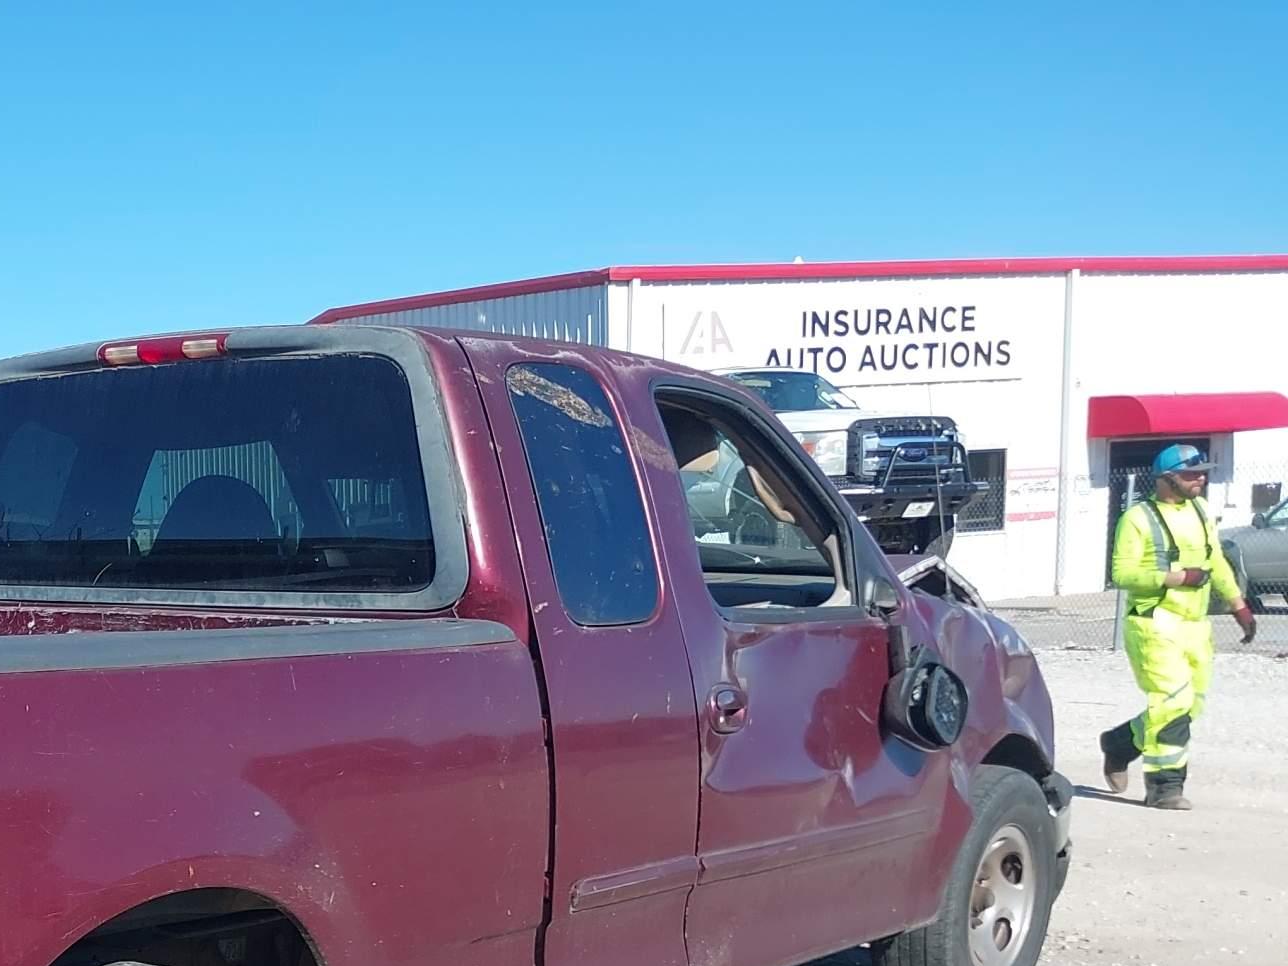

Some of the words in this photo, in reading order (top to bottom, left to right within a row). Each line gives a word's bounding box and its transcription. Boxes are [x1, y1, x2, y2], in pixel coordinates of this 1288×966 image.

[801, 306, 976, 338] INSURANCE
[765, 346, 847, 374] AUTO
[858, 340, 1011, 372] AUCTIONS
